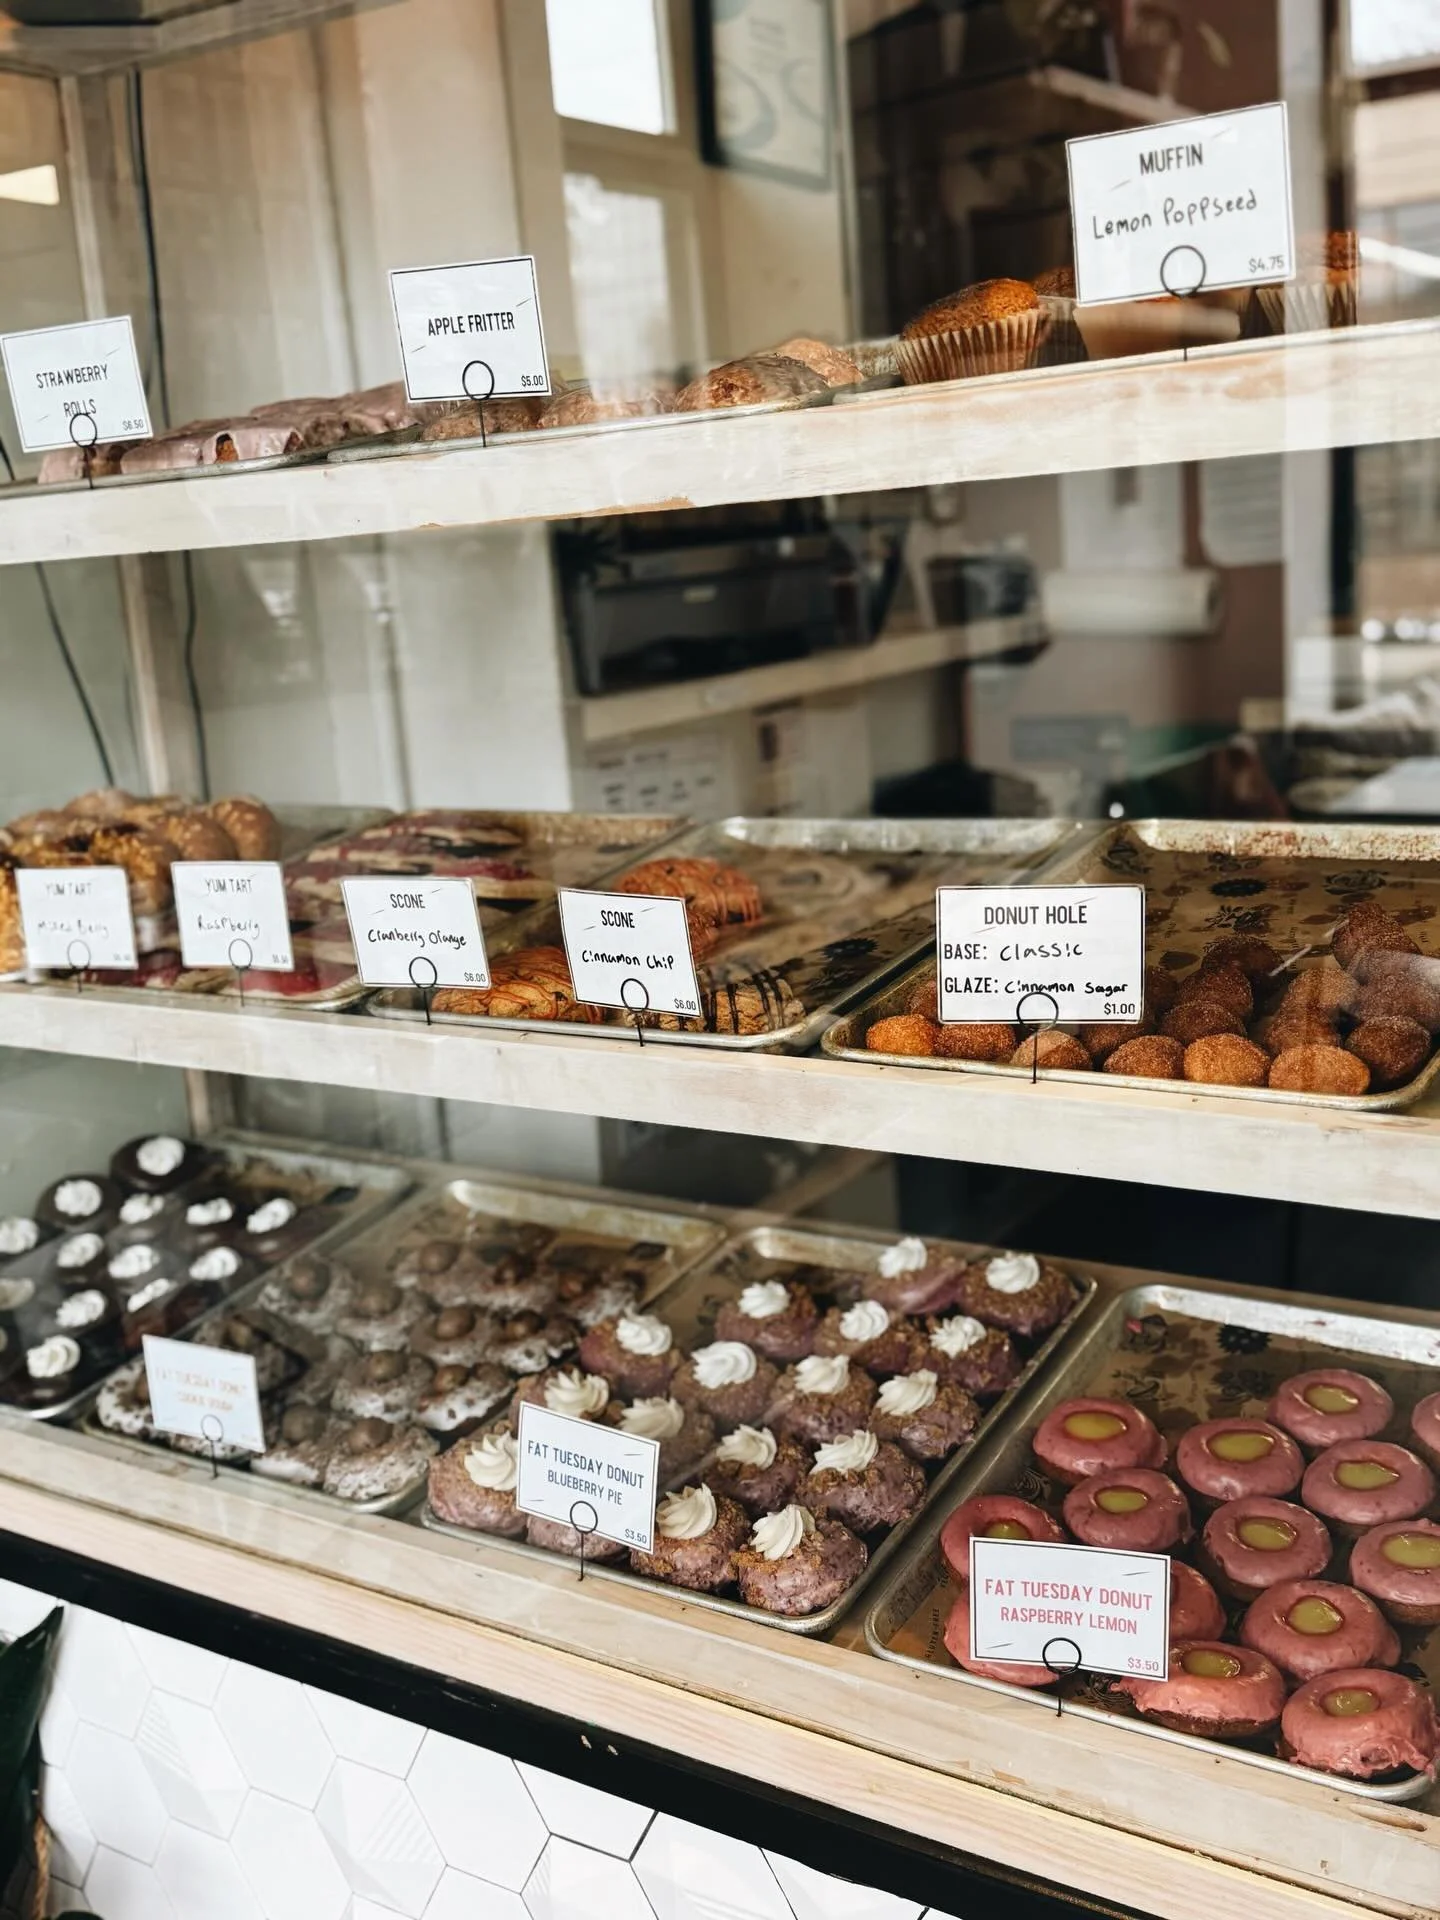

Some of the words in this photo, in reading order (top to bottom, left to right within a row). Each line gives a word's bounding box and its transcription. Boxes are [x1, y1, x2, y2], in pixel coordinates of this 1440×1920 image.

[1139, 143, 1203, 176] MUFFIN
[1092, 213, 1152, 239] Lemon
[1249, 255, 1284, 273] $4.75
[428, 316, 465, 336] APPLE
[468, 311, 515, 333] FRITTER
[36, 364, 108, 389] STRAWBERRY
[521, 374, 544, 387] $5.00
[63, 399, 97, 417] ROLLS
[228, 879, 252, 893] TART
[390, 893, 425, 909] SCONE
[601, 909, 635, 928] SCONE
[984, 906, 1039, 925] DONUT
[1046, 905, 1087, 924] HOLE
[582, 950, 640, 966] Cinnamon
[944, 943, 987, 960] BASE:
[1000, 943, 1083, 961] Classic
[944, 977, 998, 993] GLAZE:
[1004, 980, 1075, 994] Cinnamon
[674, 998, 696, 1010] $6.00
[1104, 1003, 1135, 1015] $1.00
[528, 1440, 549, 1459] FAT
[553, 1447, 603, 1476] TUESDAY
[607, 1464, 644, 1489] DONUT
[547, 1469, 604, 1499] BLUEBERRY
[608, 1488, 622, 1505] PIE
[625, 1528, 647, 1544] $3.50
[985, 1578, 1015, 1597] FAT
[1021, 1581, 1093, 1603] TUESDAY
[1099, 1588, 1152, 1610] DONUT
[1000, 1606, 1084, 1626] RASPBERRY
[1089, 1614, 1137, 1635] LEMON
[1127, 1657, 1159, 1672] $3.50
